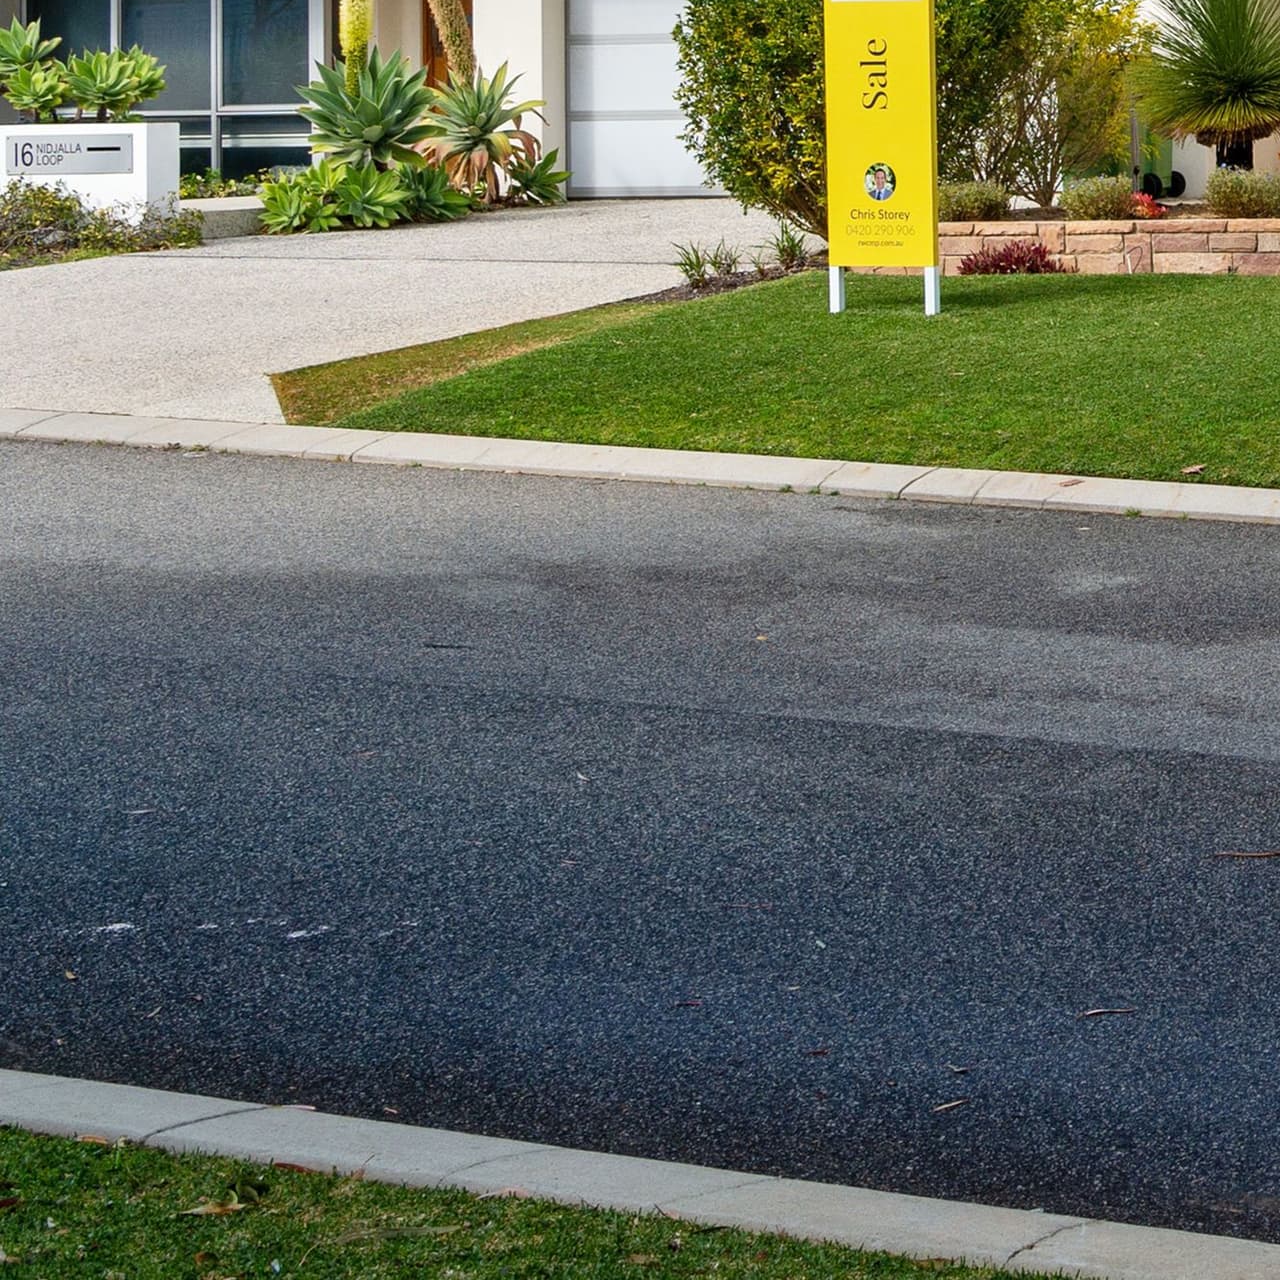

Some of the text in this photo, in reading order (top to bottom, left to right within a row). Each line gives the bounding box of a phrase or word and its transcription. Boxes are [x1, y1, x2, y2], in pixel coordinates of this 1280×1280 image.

[860, 38, 888, 110] Sale
[14, 142, 82, 167] 16 NIDJALLA
[36, 154, 64, 166] LOOP
[850, 208, 911, 221] Chris Storey
[846, 224, 917, 236] 0420 290 906
